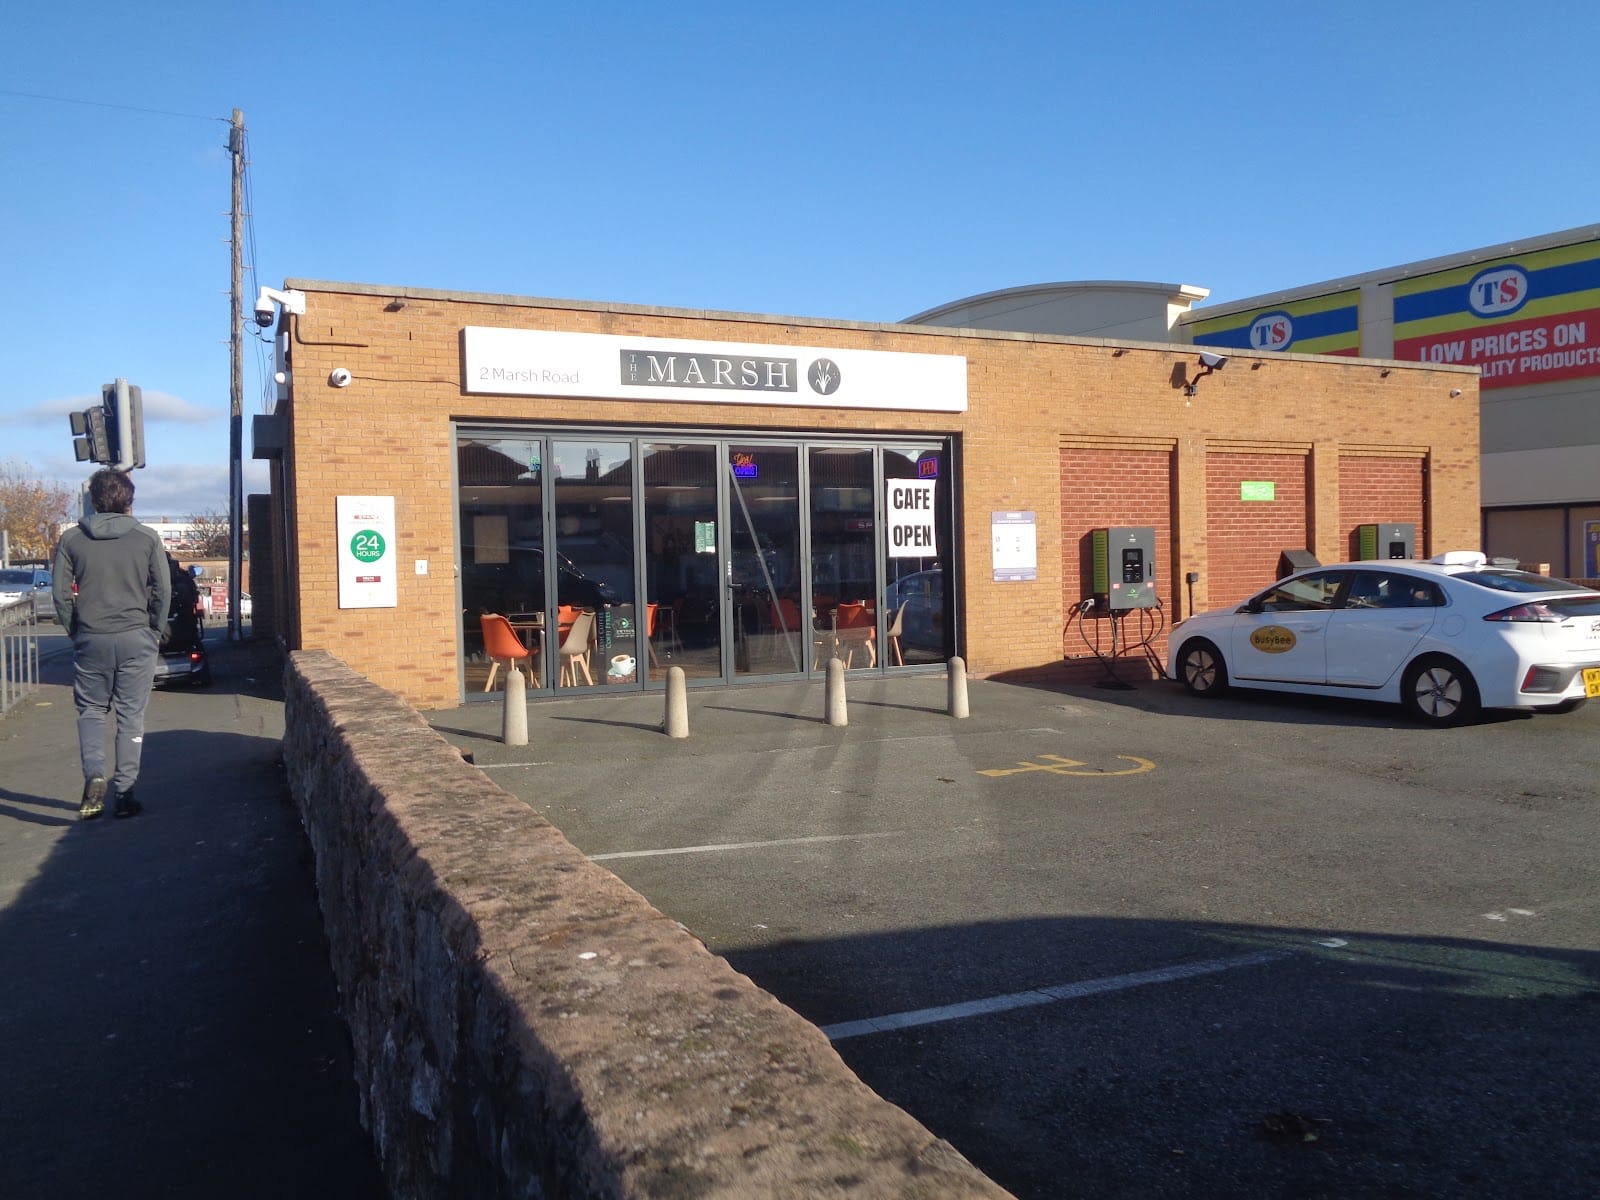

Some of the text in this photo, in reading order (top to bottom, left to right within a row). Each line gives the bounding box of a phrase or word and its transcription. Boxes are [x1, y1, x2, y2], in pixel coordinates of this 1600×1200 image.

[1478, 277, 1518, 306] TS
[1256, 322, 1285, 346] TS
[1471, 327, 1548, 359] PRICES
[1553, 322, 1586, 347] ON
[479, 366, 580, 384] 2 Marsh Road
[630, 354, 638, 382] THE
[647, 355, 790, 388] MARSH
[893, 487, 930, 510] CAFE
[356, 534, 380, 550] 24
[893, 524, 932, 547] OPEN
